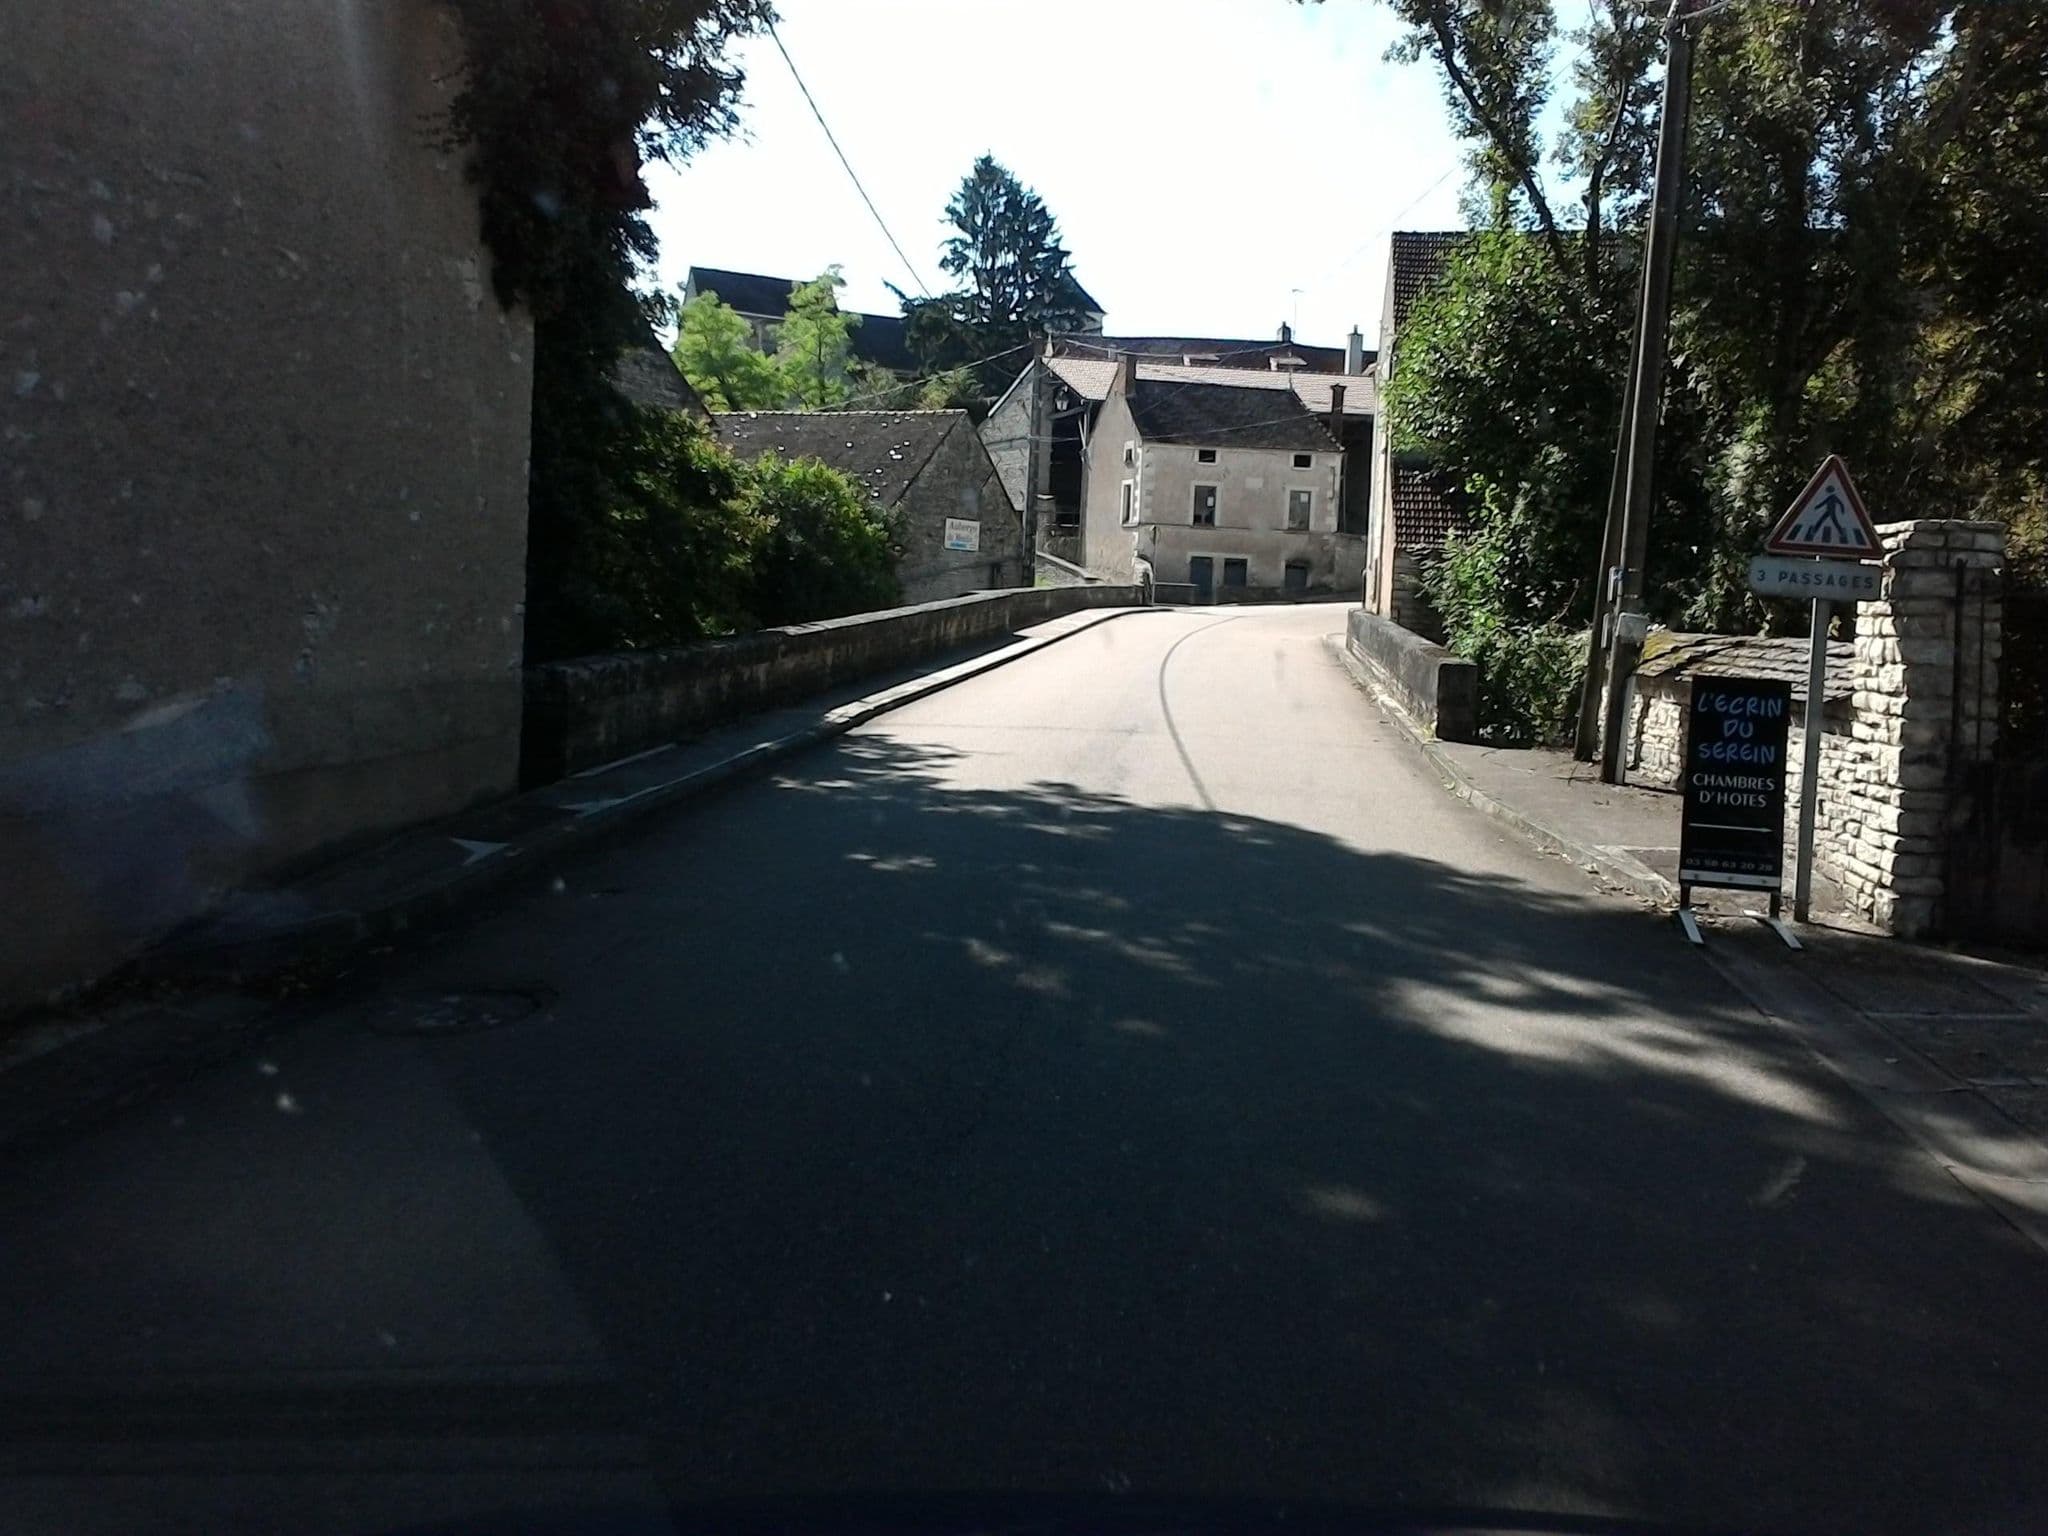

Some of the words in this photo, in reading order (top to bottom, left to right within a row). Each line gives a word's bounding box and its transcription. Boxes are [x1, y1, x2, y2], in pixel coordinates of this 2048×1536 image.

[1757, 570, 1766, 581] 3
[1778, 571, 1874, 589] PASSAGES
[1697, 691, 1783, 719] L'ECRIN
[1722, 719, 1755, 739] DU
[1697, 741, 1776, 765] SEREIN
[1692, 773, 1776, 792] CHAMBRES
[1698, 791, 1768, 809] D'HOTES
